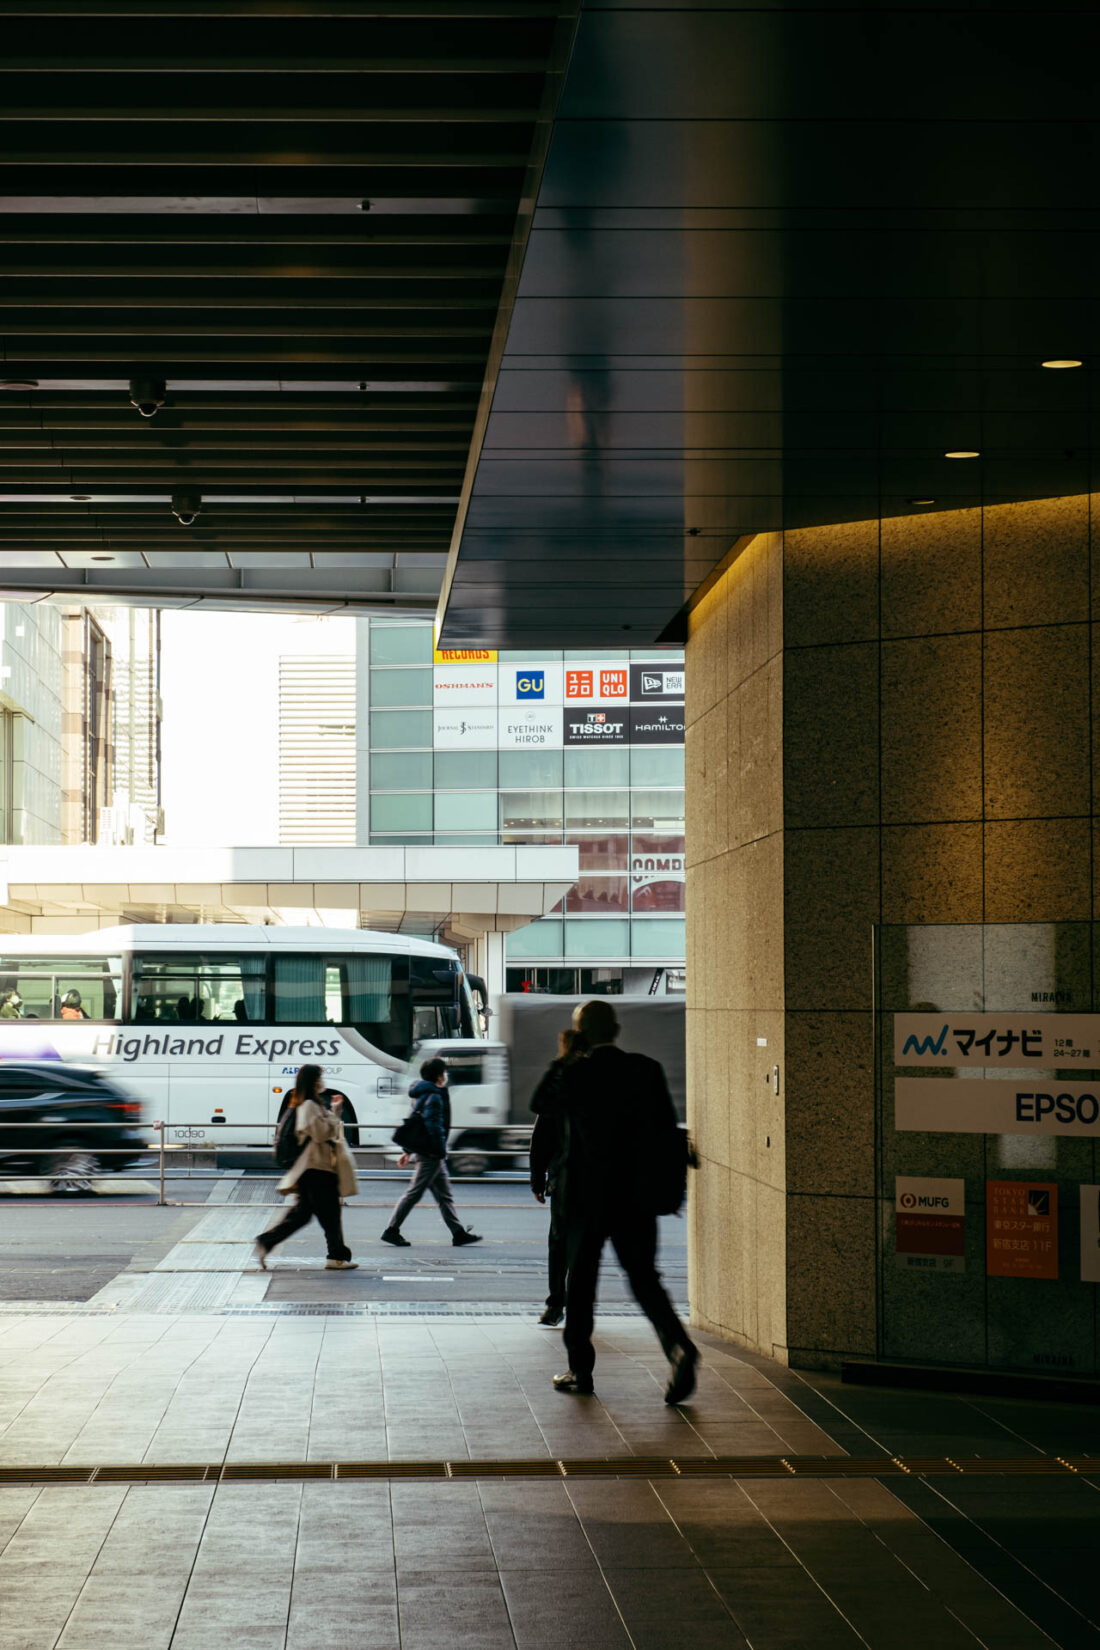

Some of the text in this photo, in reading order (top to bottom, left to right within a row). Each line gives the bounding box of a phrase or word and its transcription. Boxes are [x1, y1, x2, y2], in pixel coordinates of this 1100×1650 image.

[602, 672, 623, 683] UNI
[666, 676, 682, 684] NEW
[517, 678, 544, 692] GU
[602, 684, 625, 696] QLO
[508, 725, 553, 734] EYETHINK
[569, 723, 623, 734] TISSOT
[92, 1034, 341, 1062] Highland Express
[953, 1029, 1043, 1057] マイナビ
[1016, 1093, 1100, 1124] EPSO
[174, 1129, 206, 1139] 10090
[918, 1196, 950, 1208] MUFG
